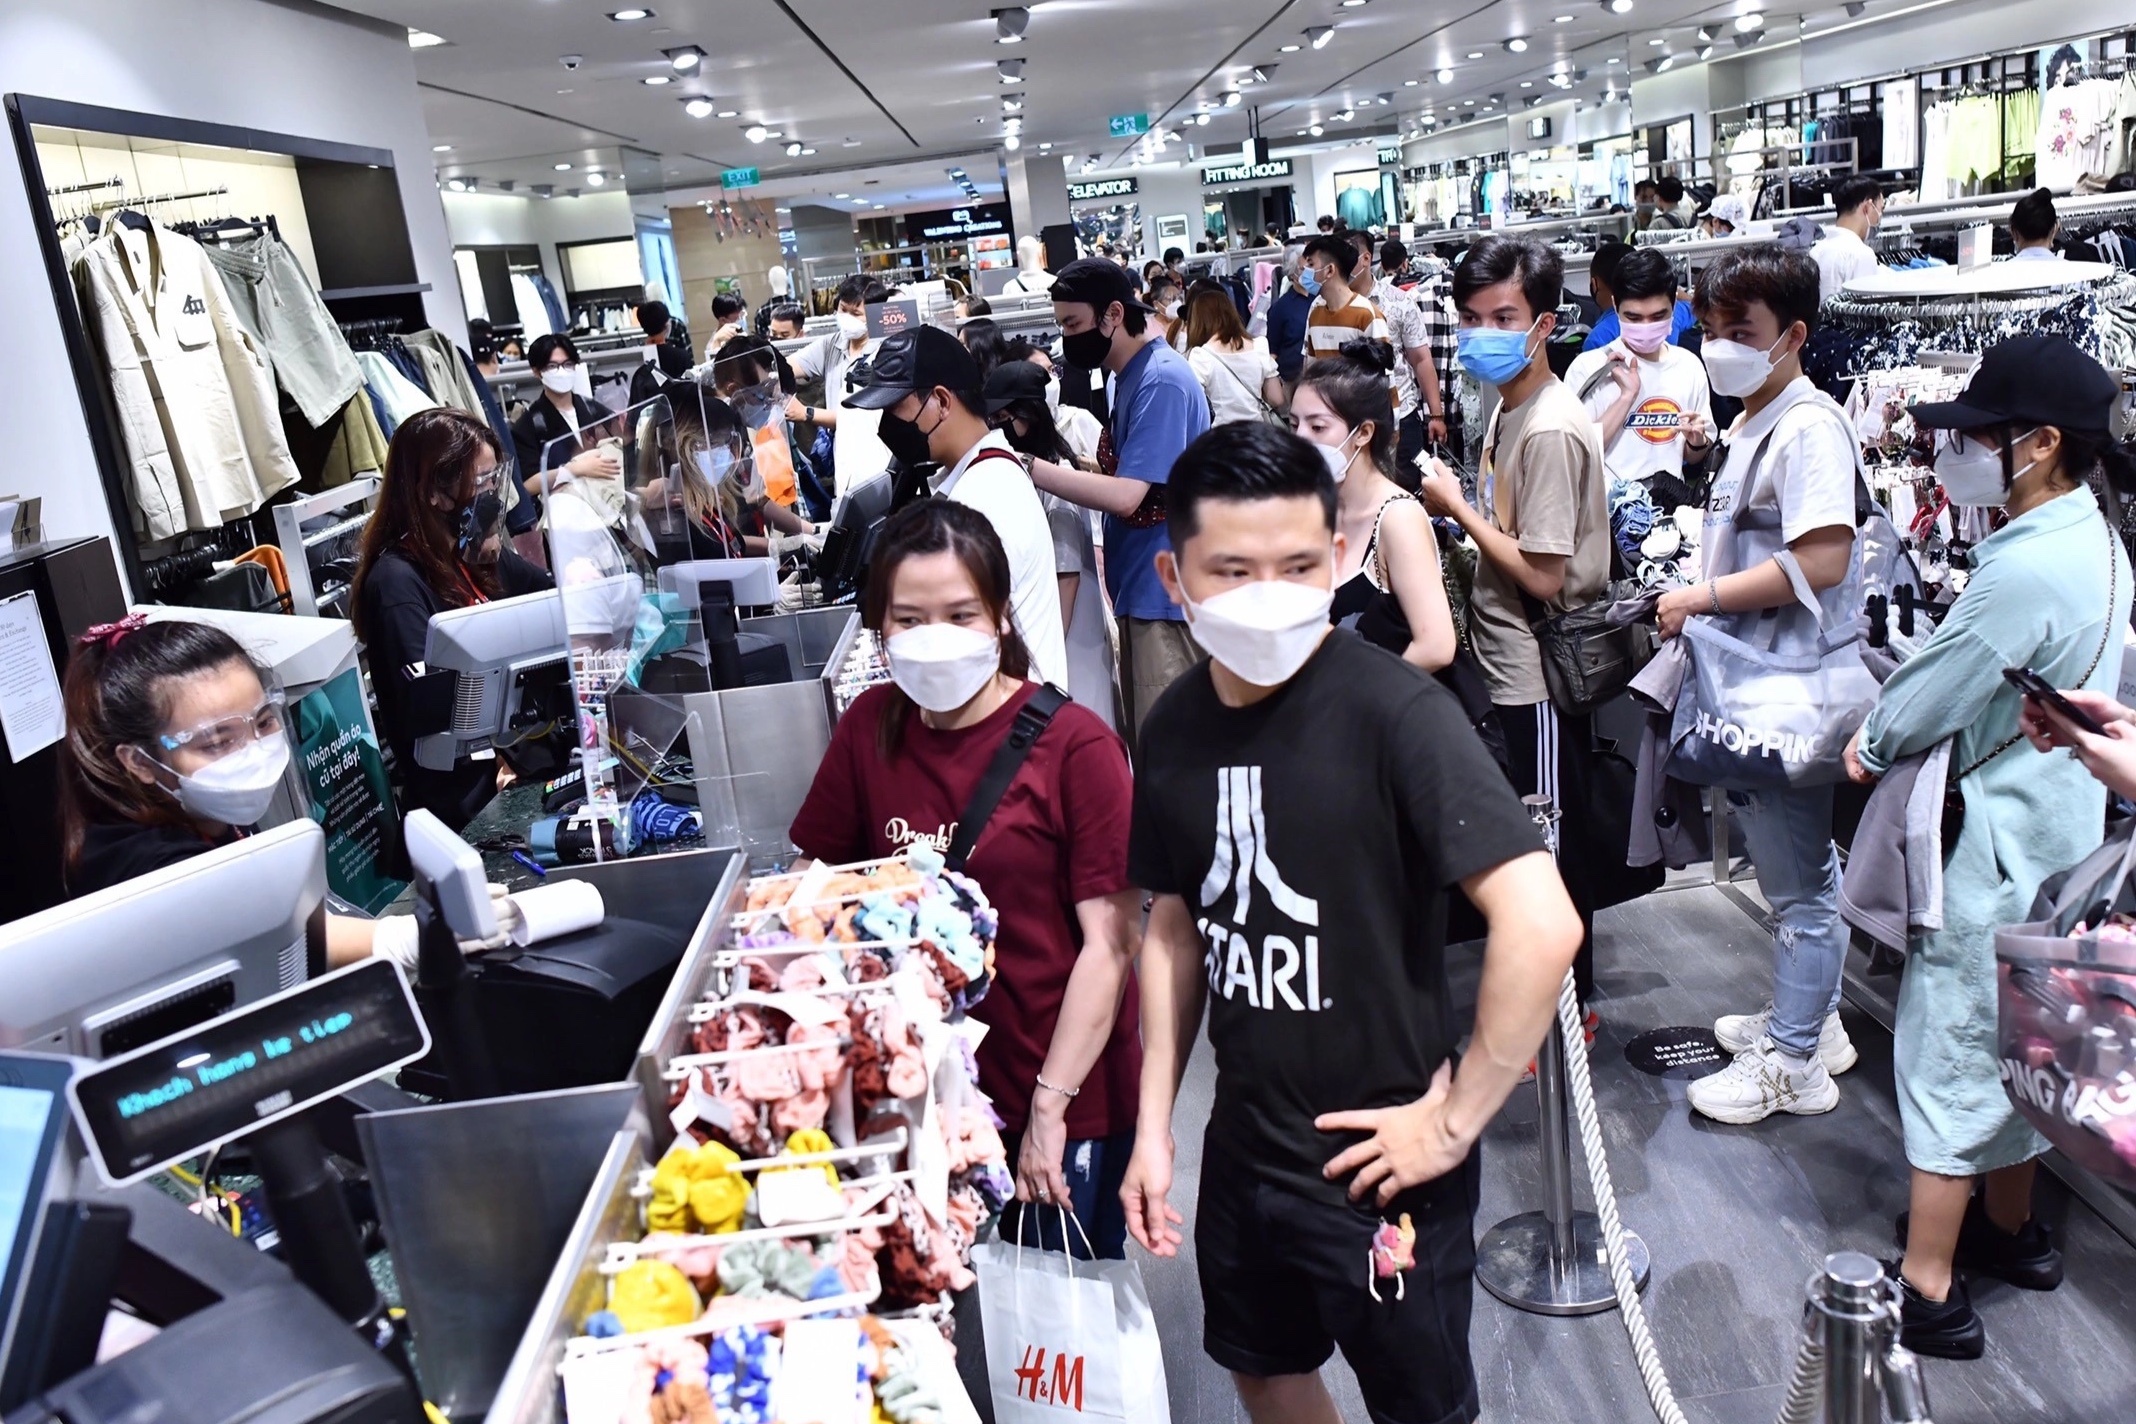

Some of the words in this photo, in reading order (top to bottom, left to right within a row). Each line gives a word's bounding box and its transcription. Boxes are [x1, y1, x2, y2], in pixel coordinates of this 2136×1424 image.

[727, 170, 752, 182] EXIT
[1205, 165, 1250, 183] FITTING
[1072, 180, 1132, 198] ELEVATOR
[878, 313, 908, 326] -50%
[306, 745, 331, 771] Nhận
[330, 729, 352, 755] quần
[350, 724, 362, 740] áo
[319, 771, 331, 788] cũ
[330, 760, 344, 781] tại
[341, 745, 361, 769] đây!
[1654, 1045, 1671, 1053] Be
[1654, 1052, 1686, 1061] keep
[1686, 1046, 1715, 1057] your
[1665, 1054, 1720, 1067] distance
[2061, 1070, 2136, 1128] BAG
[1014, 1344, 1084, 1413] H&M
